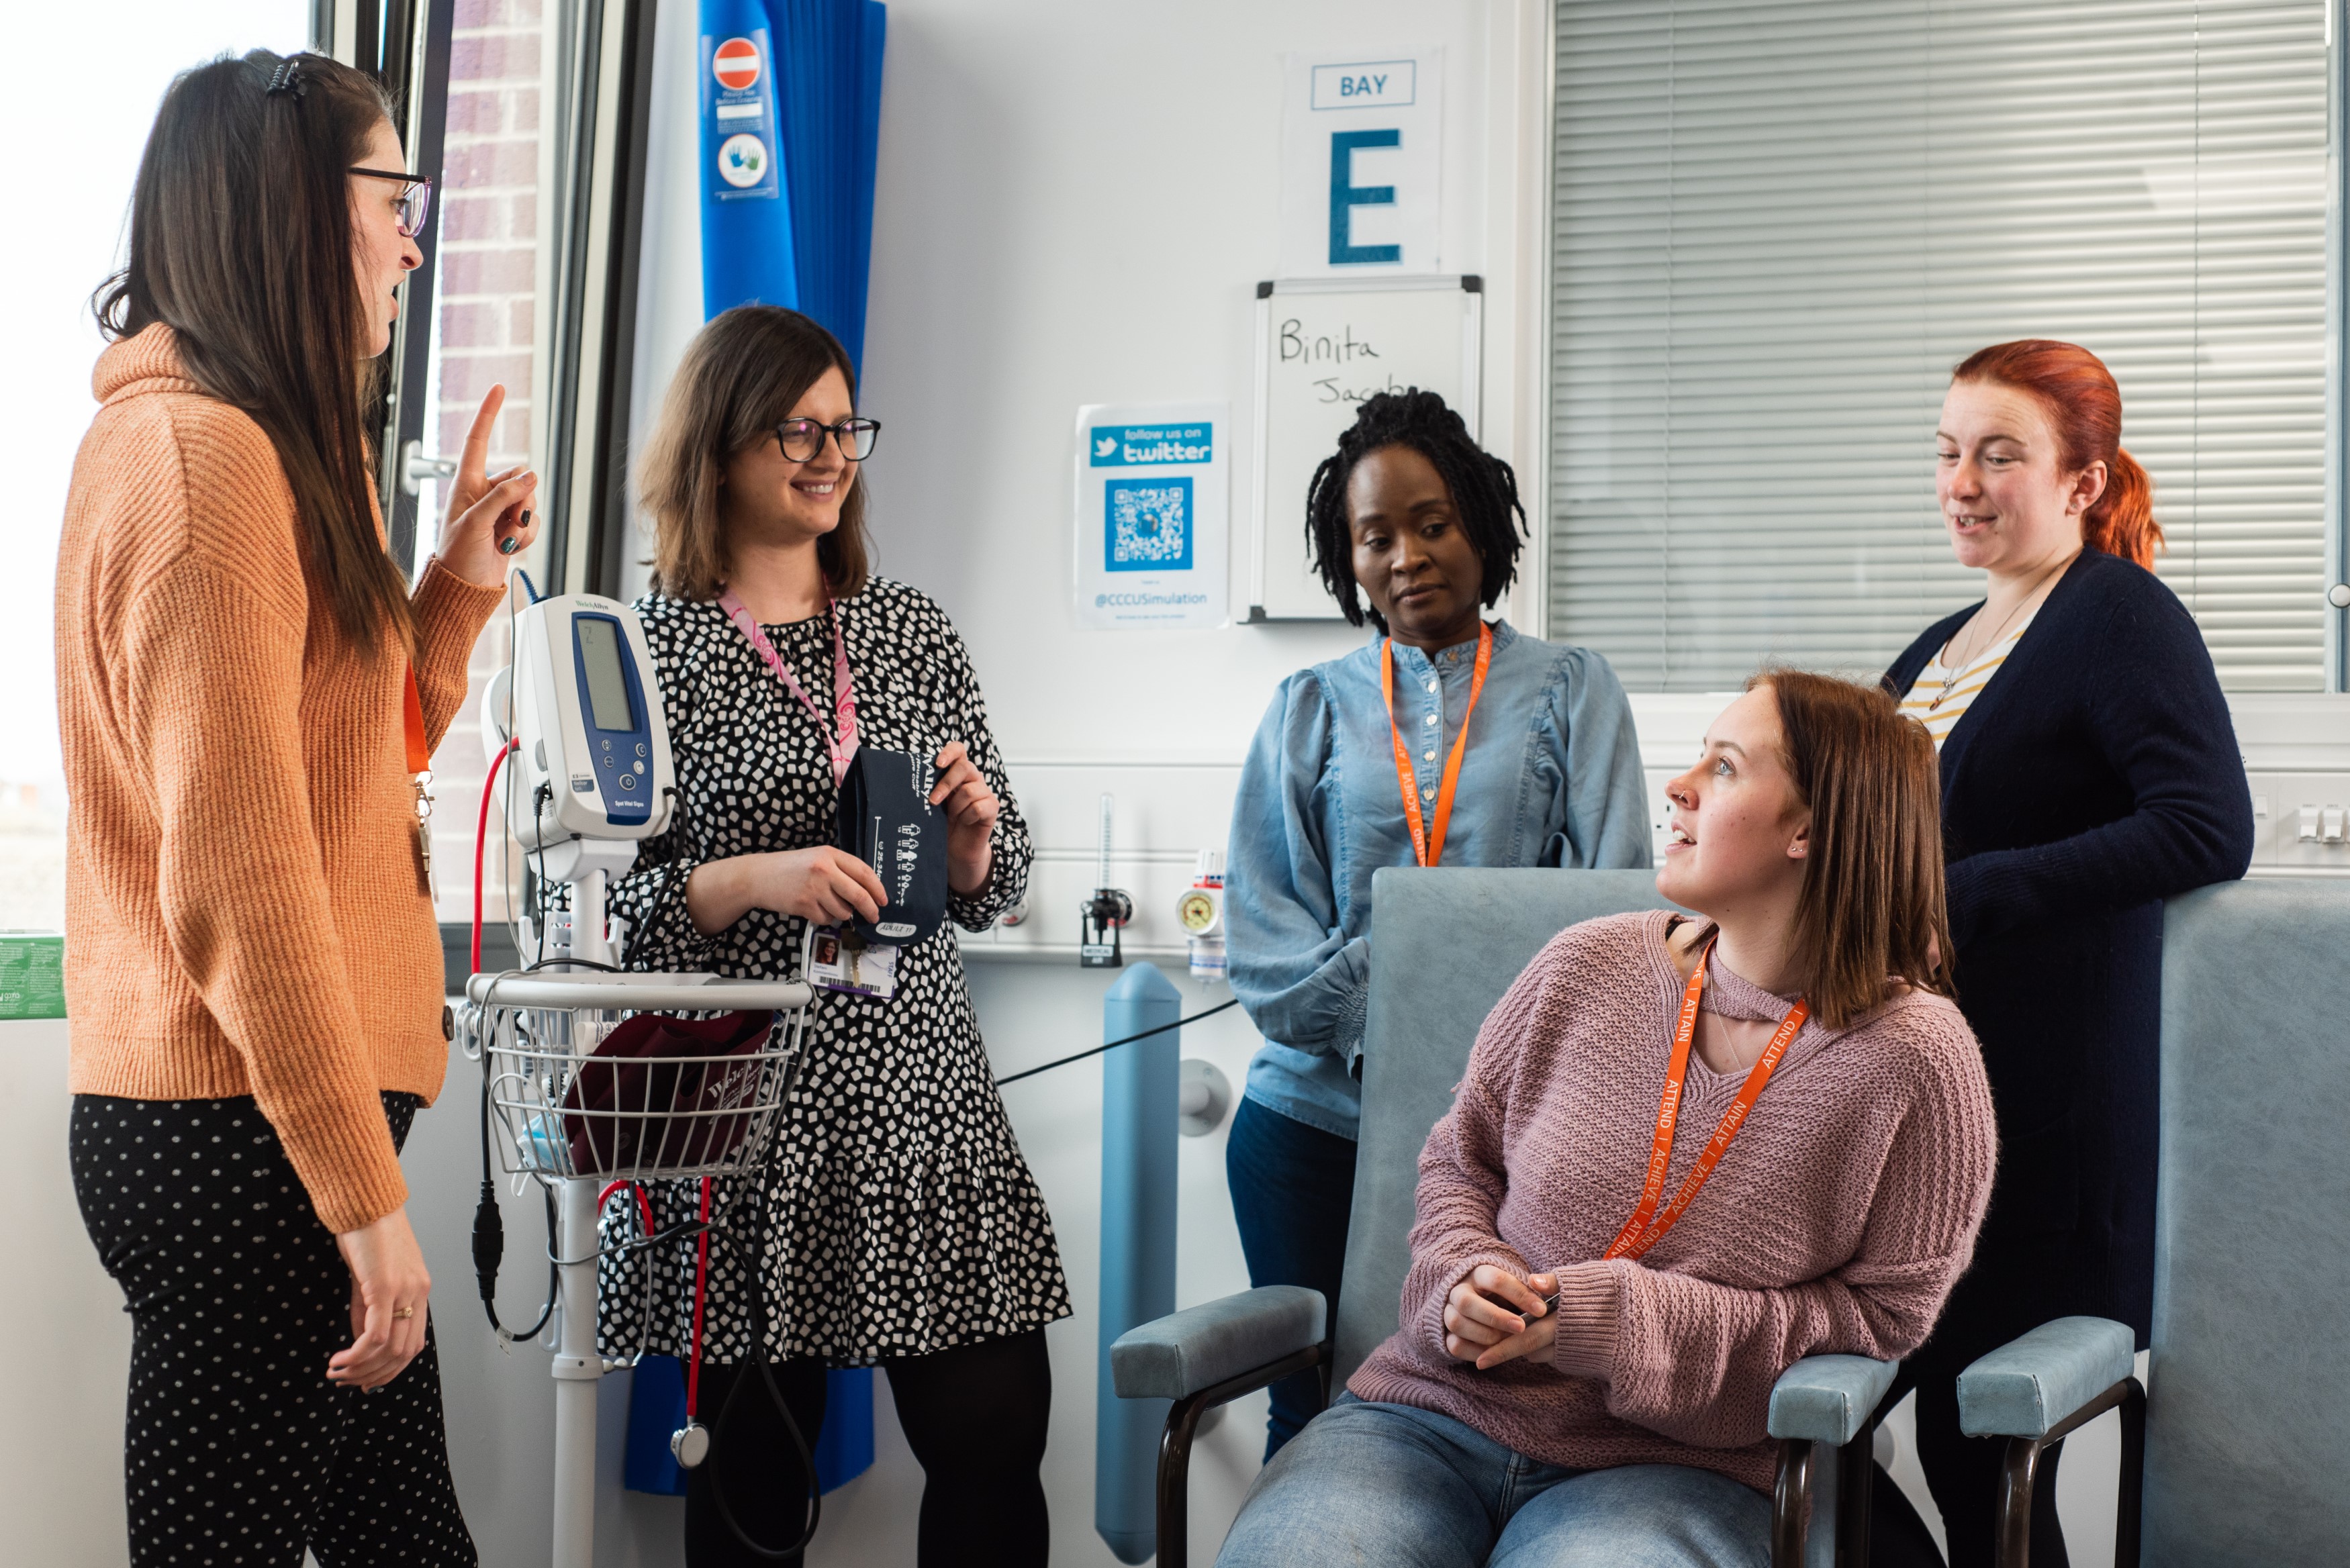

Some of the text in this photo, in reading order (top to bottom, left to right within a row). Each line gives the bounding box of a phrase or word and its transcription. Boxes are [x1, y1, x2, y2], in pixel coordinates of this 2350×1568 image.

[1340, 75, 1388, 96] BAY
[1329, 128, 1402, 265] E
[1280, 319, 1380, 364] Binita
[1123, 442, 1211, 462] twitter
[1125, 428, 1202, 440] follow us on
[1094, 593, 1207, 609] @CCCUSimulation
[1402, 773, 1418, 812] ACHIEVE
[880, 923, 904, 932] ADULT
[1678, 998, 1697, 1042] ATTAIN
[1661, 1079, 1679, 1129] ATTEND
[1620, 1020, 1797, 1259] TTEND ACHIEVE ATTAIN ATTEND
[1645, 1147, 1666, 1204] ACHIEVE
